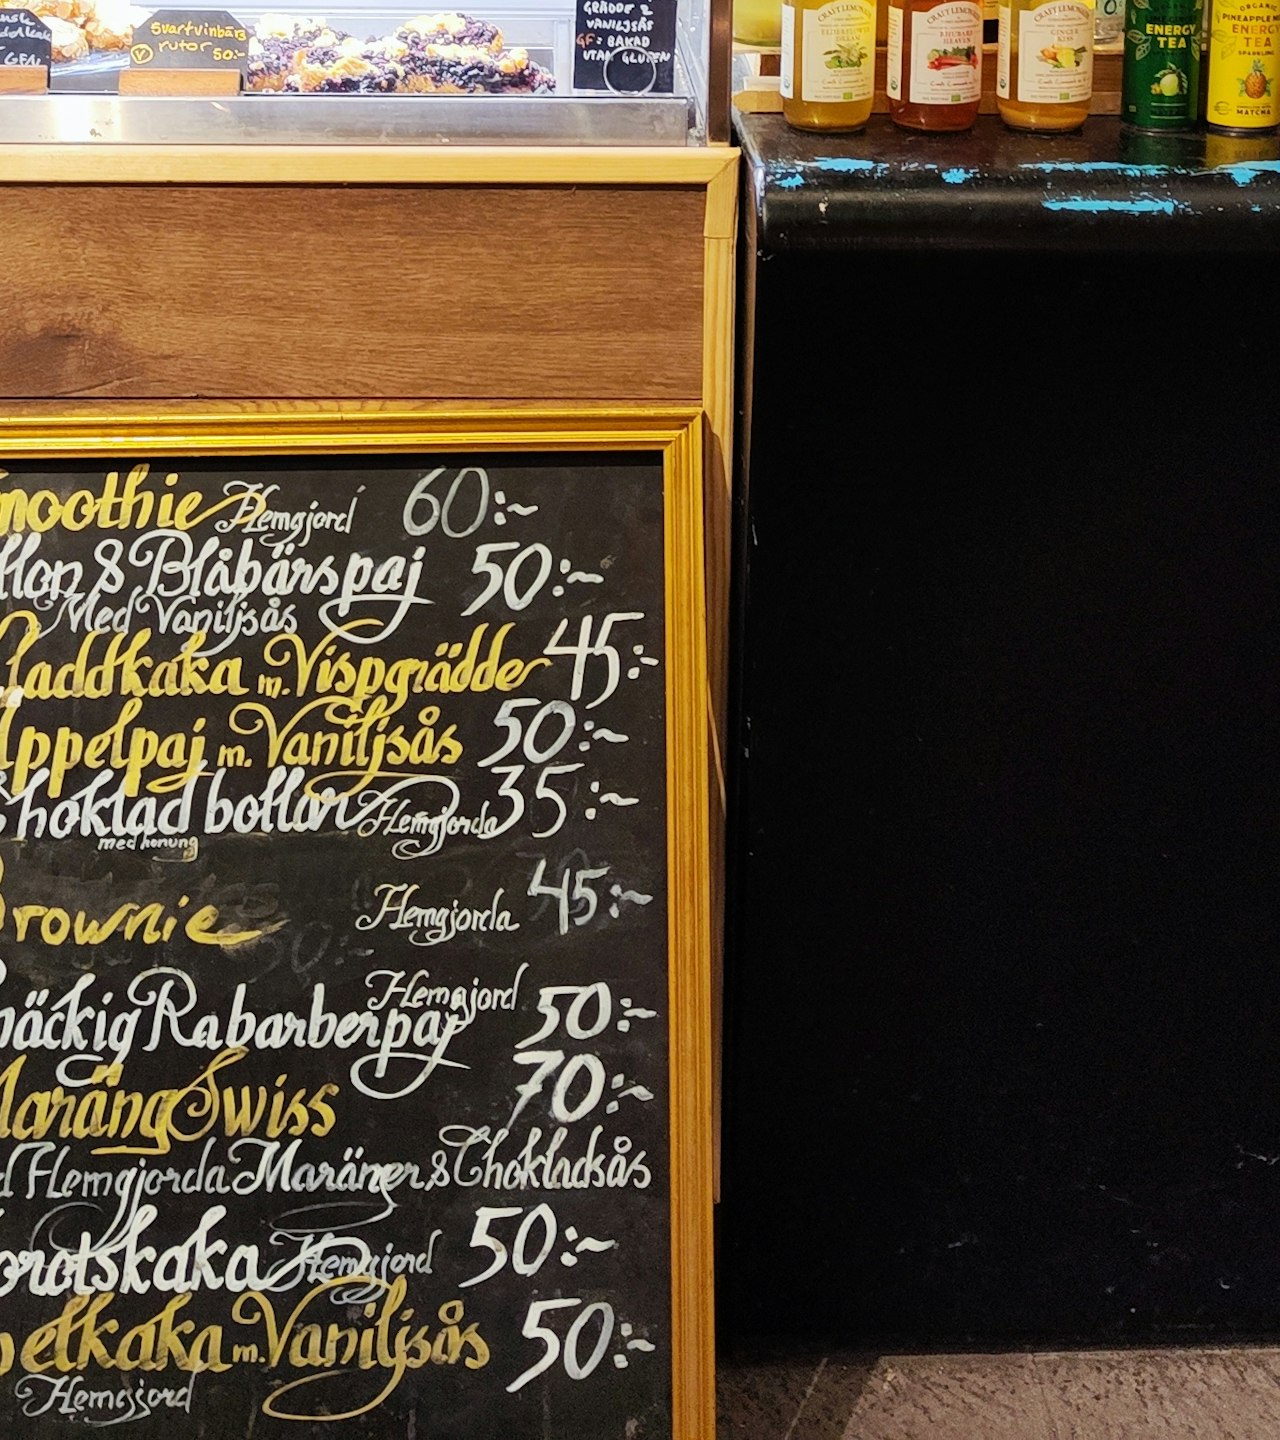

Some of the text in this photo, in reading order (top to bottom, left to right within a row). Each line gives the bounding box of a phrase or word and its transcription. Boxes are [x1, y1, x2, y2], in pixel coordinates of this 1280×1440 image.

[1146, 24, 1196, 35] ENERGY
[1222, 13, 1270, 22] PINEAPPLE
[1232, 24, 1280, 34] ENERGY
[607, 35, 650, 47] BAKAD
[1157, 37, 1187, 48] TEA
[1244, 38, 1272, 47] TEA
[35, 594, 299, 658] Med Vaniljsås
[262, 617, 553, 708] Vispgrädde
[228, 697, 464, 800] Vaniljsås
[97, 834, 199, 862] med honung
[354, 883, 520, 948] Hemgjorda
[357, 962, 529, 1032] Hemgjord
[234, 1275, 490, 1420] Vaniljsås
[15, 1372, 195, 1427] Hemgjord
